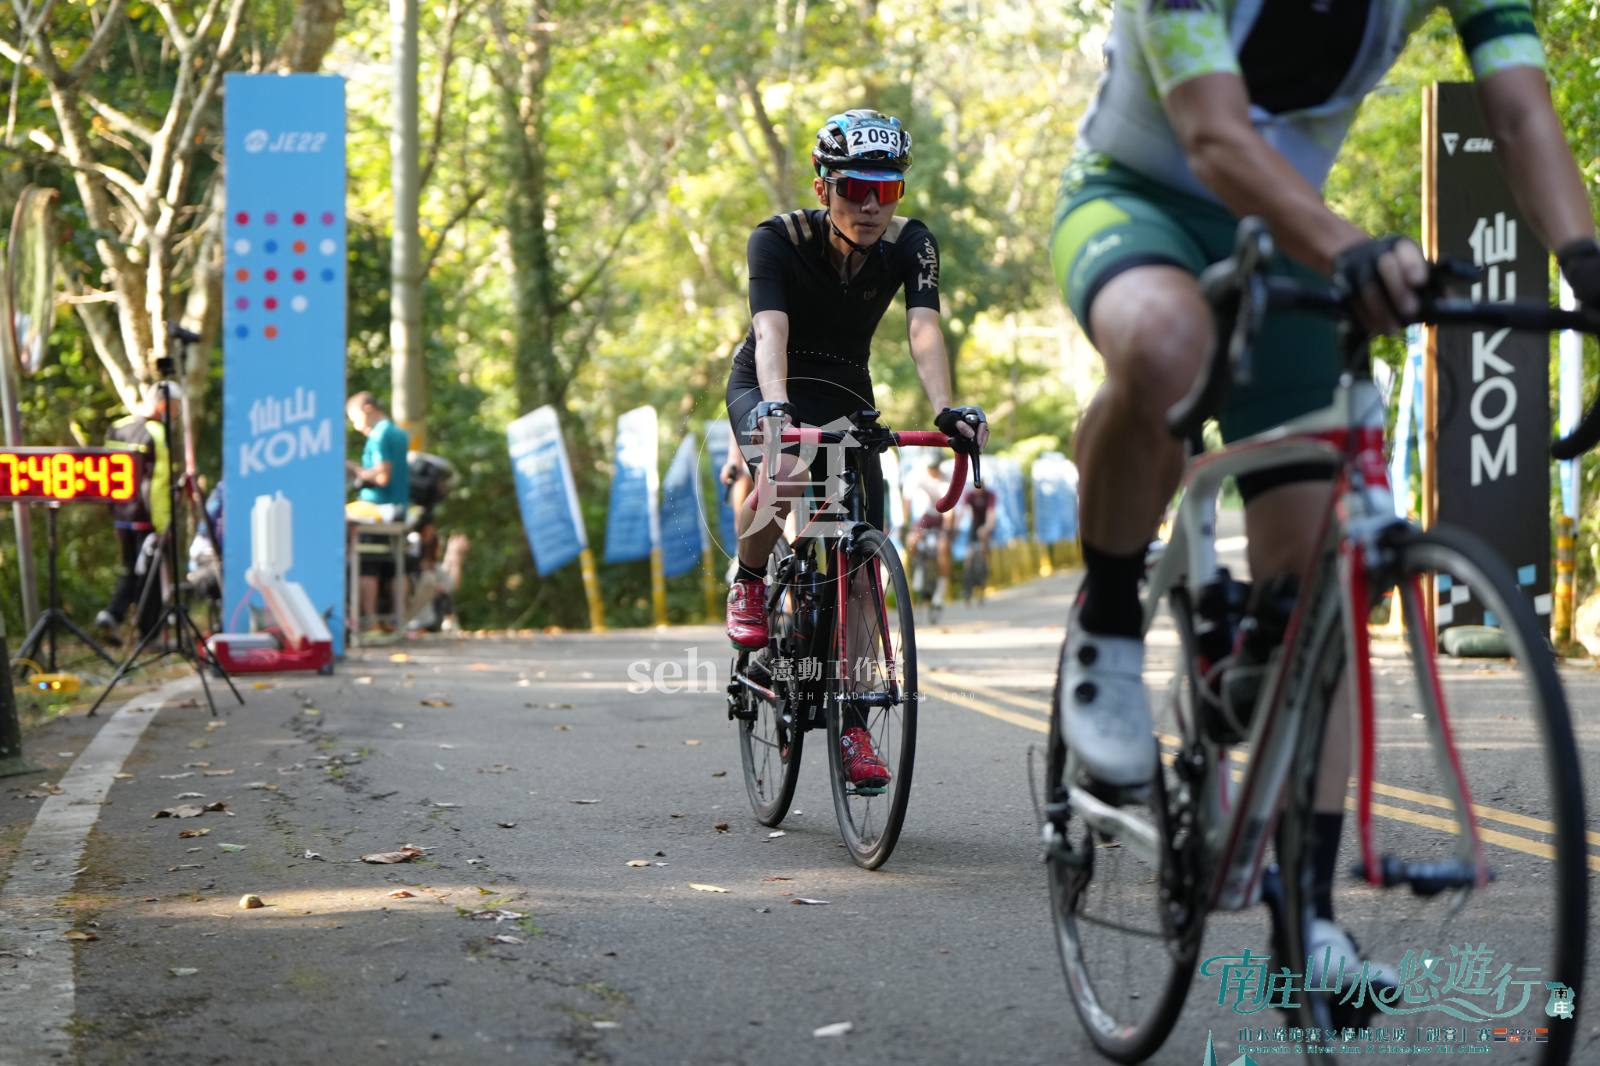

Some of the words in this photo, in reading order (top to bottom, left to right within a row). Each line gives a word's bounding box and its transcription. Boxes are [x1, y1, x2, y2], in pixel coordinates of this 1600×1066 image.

[248, 385, 315, 437] 仙山
[1470, 326, 1517, 486] KOM
[240, 418, 332, 477] KOM
